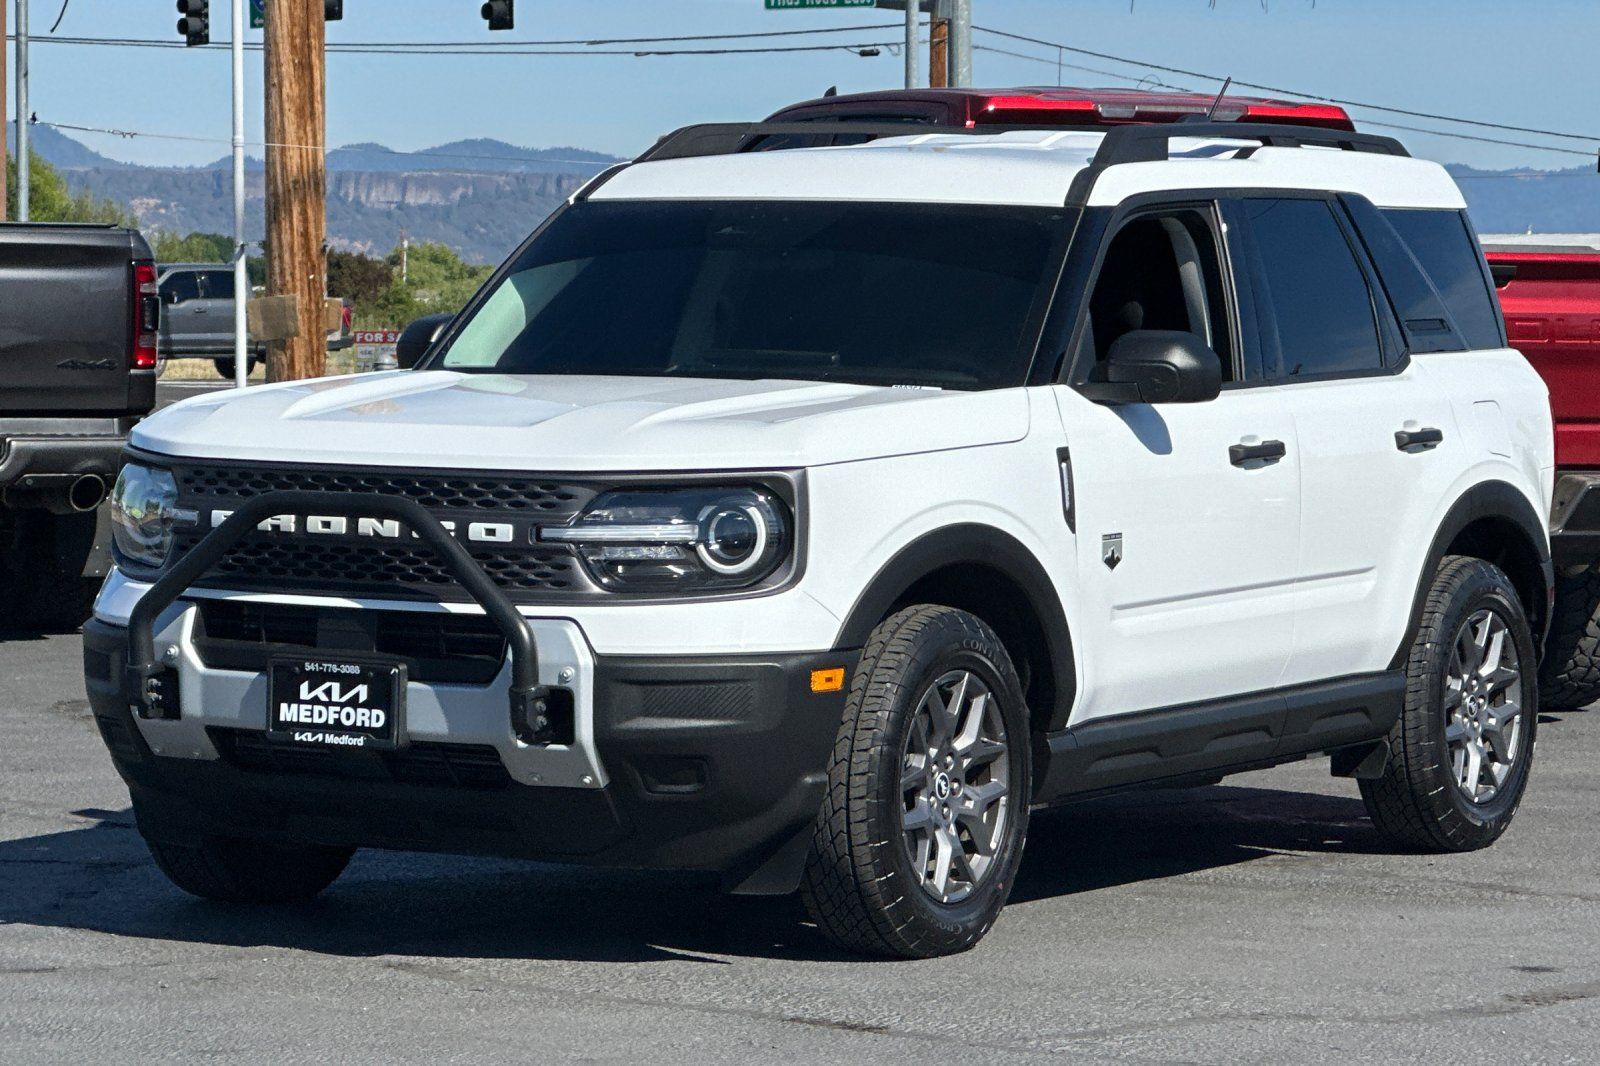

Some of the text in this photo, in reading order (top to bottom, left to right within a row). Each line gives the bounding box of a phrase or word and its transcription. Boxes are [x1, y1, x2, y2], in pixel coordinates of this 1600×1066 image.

[356, 332, 384, 343] FOR
[211, 509, 514, 542] RONO
[299, 680, 369, 704] KIA
[279, 702, 386, 728] MEDFORD
[294, 731, 365, 746] KIA Medford
